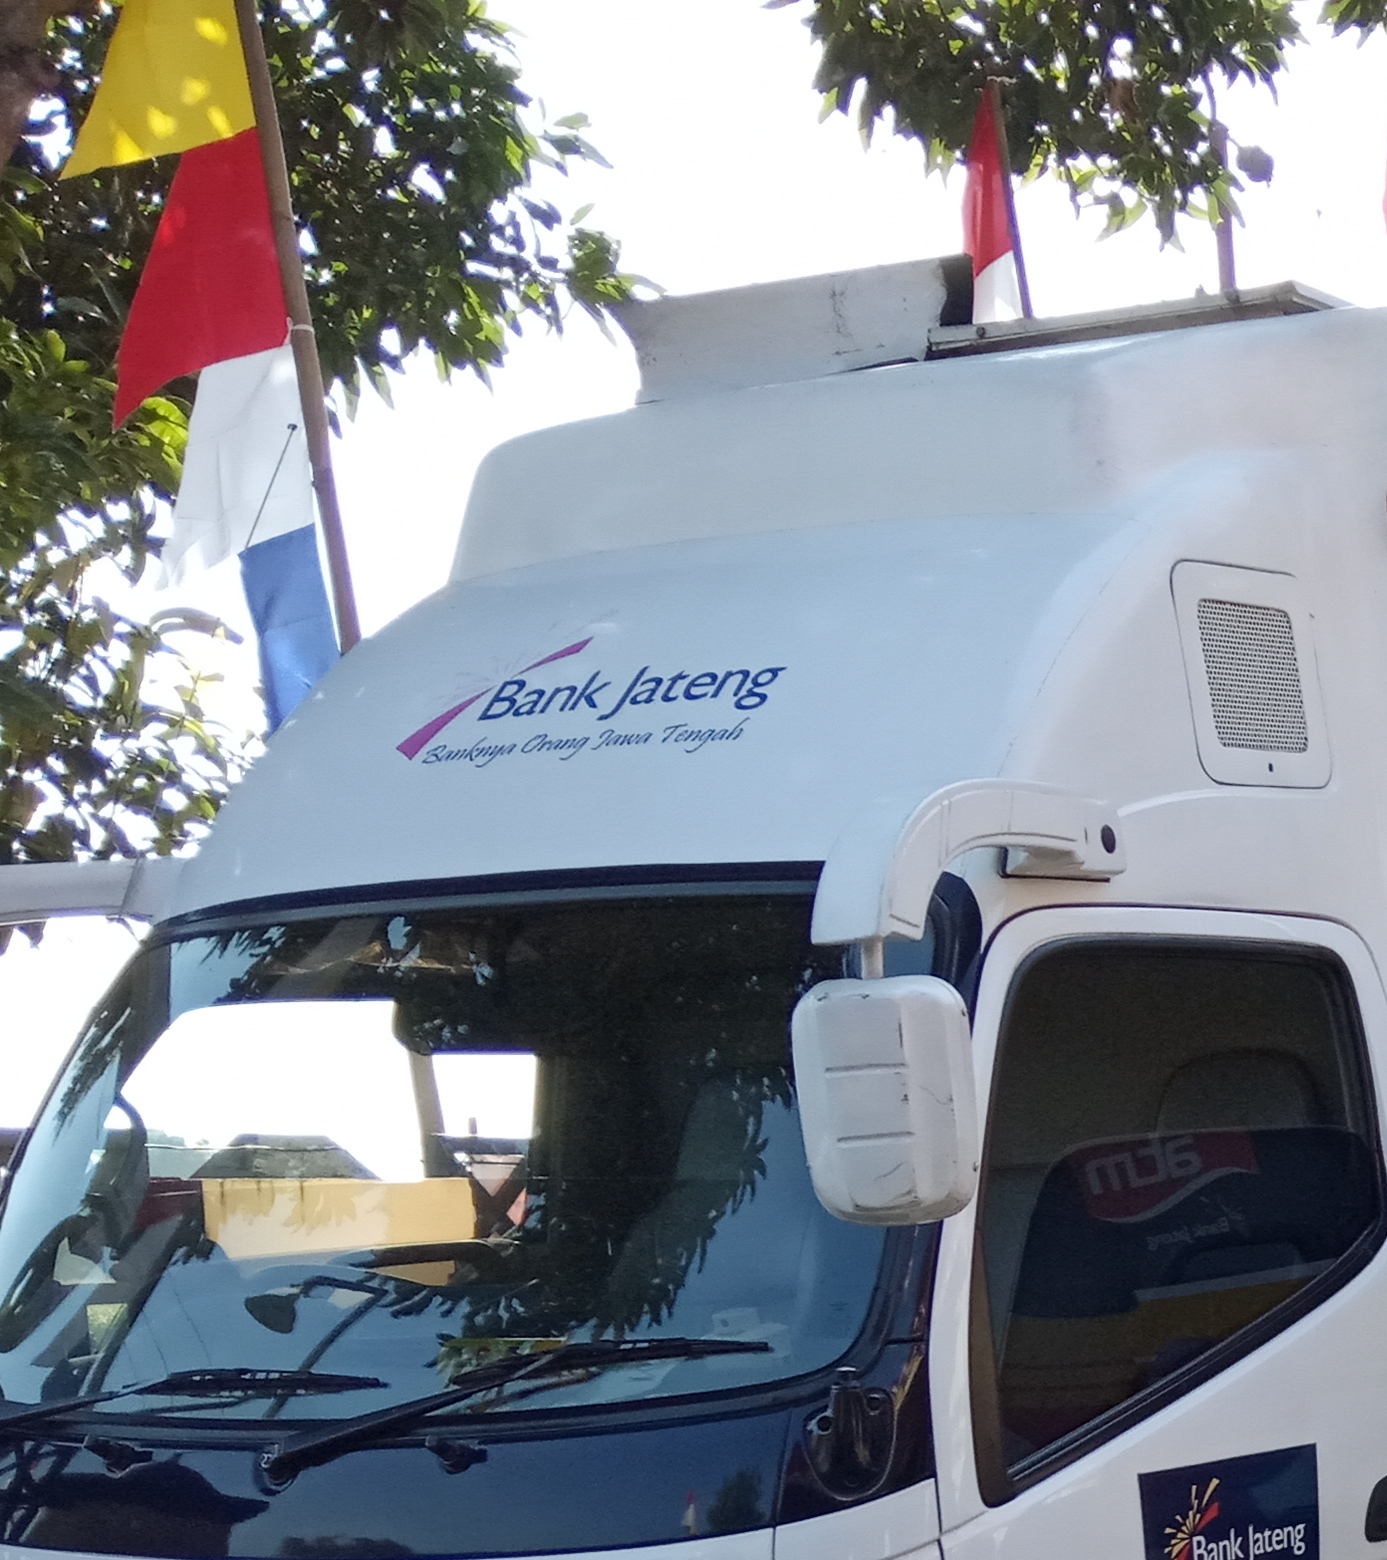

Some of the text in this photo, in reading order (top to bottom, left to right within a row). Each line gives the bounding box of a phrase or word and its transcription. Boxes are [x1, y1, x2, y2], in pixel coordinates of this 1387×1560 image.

[478, 665, 788, 722] Bank Jateng
[422, 717, 751, 767] Banknya Orang Jawa Tengah
